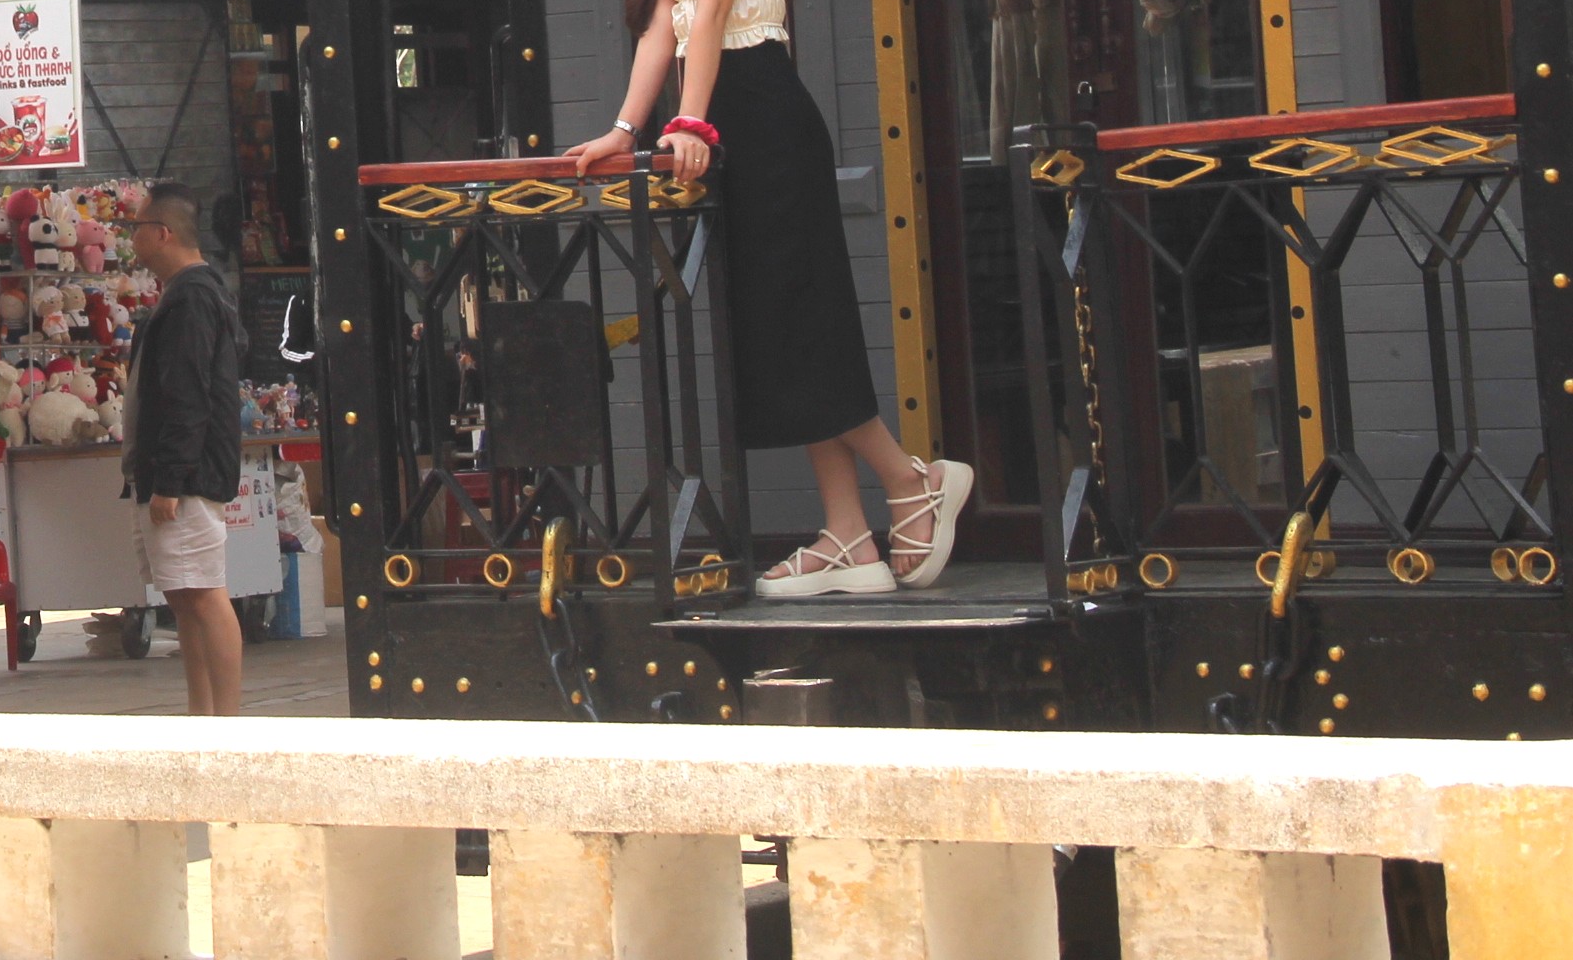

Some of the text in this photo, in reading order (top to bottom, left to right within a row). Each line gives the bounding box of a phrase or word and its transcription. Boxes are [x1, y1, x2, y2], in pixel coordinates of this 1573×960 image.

[51, 47, 60, 59] &
[35, 61, 73, 77] NHANH
[19, 80, 26, 88] &
[28, 77, 67, 88] fastfood
